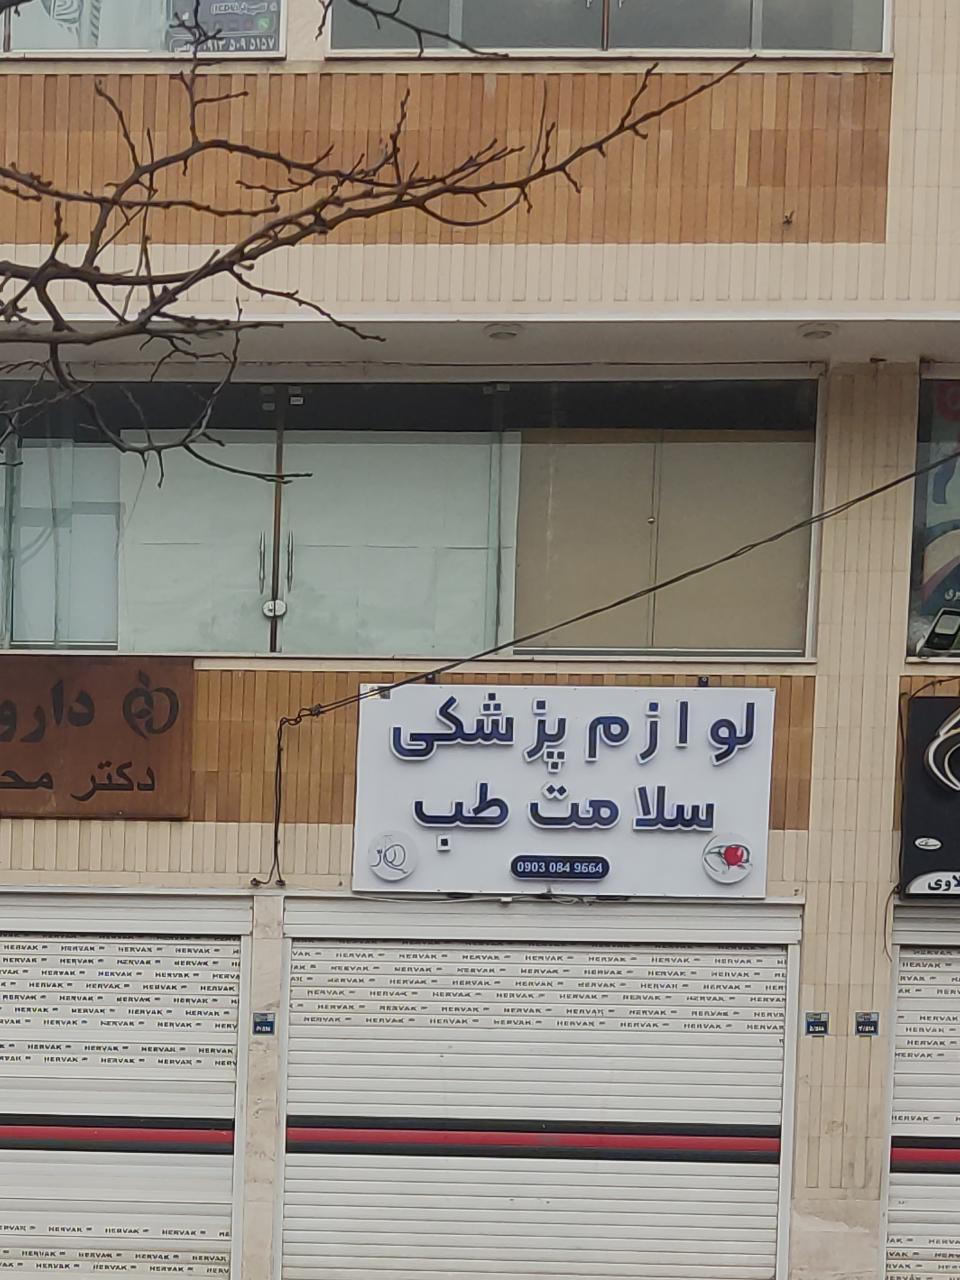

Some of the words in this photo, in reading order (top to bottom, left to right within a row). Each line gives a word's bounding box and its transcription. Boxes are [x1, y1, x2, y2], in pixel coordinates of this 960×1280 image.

[390, 691, 568, 773] پزشکی
[70, 760, 155, 801] دکتر
[412, 781, 510, 852] طب
[527, 781, 716, 832] سلامت
[516, 861, 546, 874] 0903
[549, 861, 571, 874] 084
[574, 862, 603, 875] 9664
